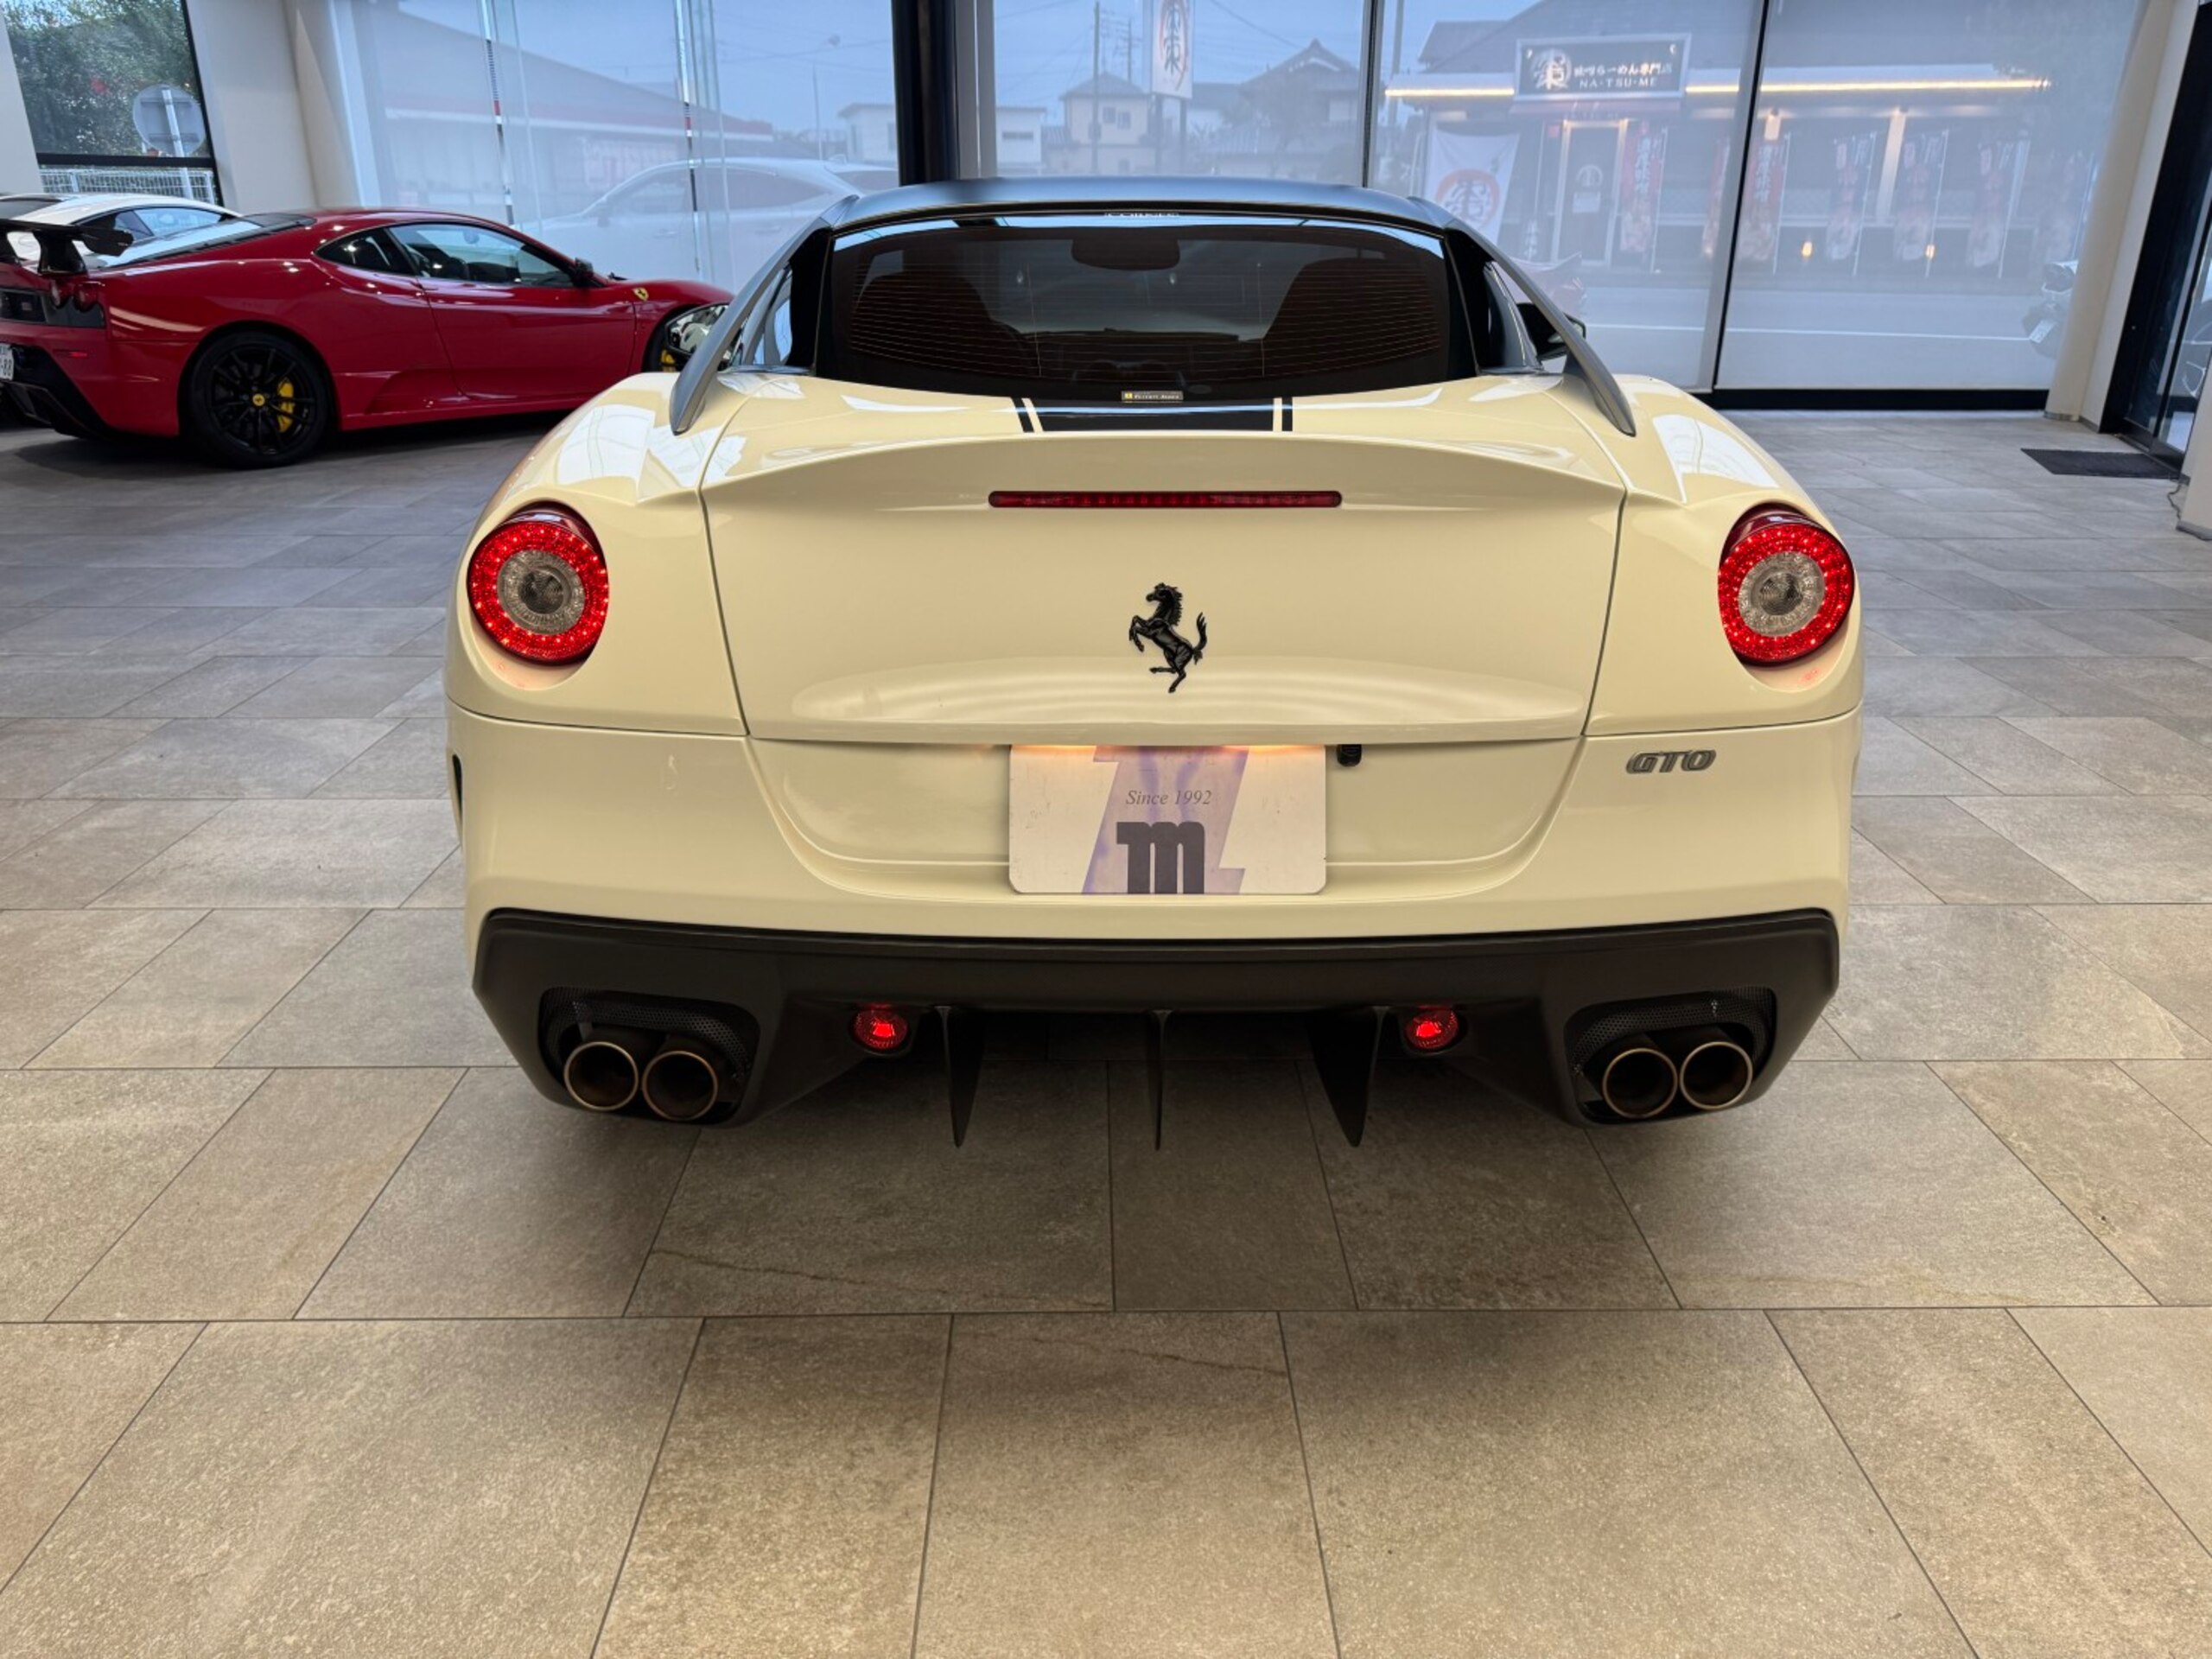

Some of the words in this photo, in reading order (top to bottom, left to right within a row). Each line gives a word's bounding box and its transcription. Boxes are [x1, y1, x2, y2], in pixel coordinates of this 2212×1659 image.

[1626, 749, 1717, 774] GTO
[1126, 790, 1168, 805] Since
[1173, 790, 1213, 805] 1992
